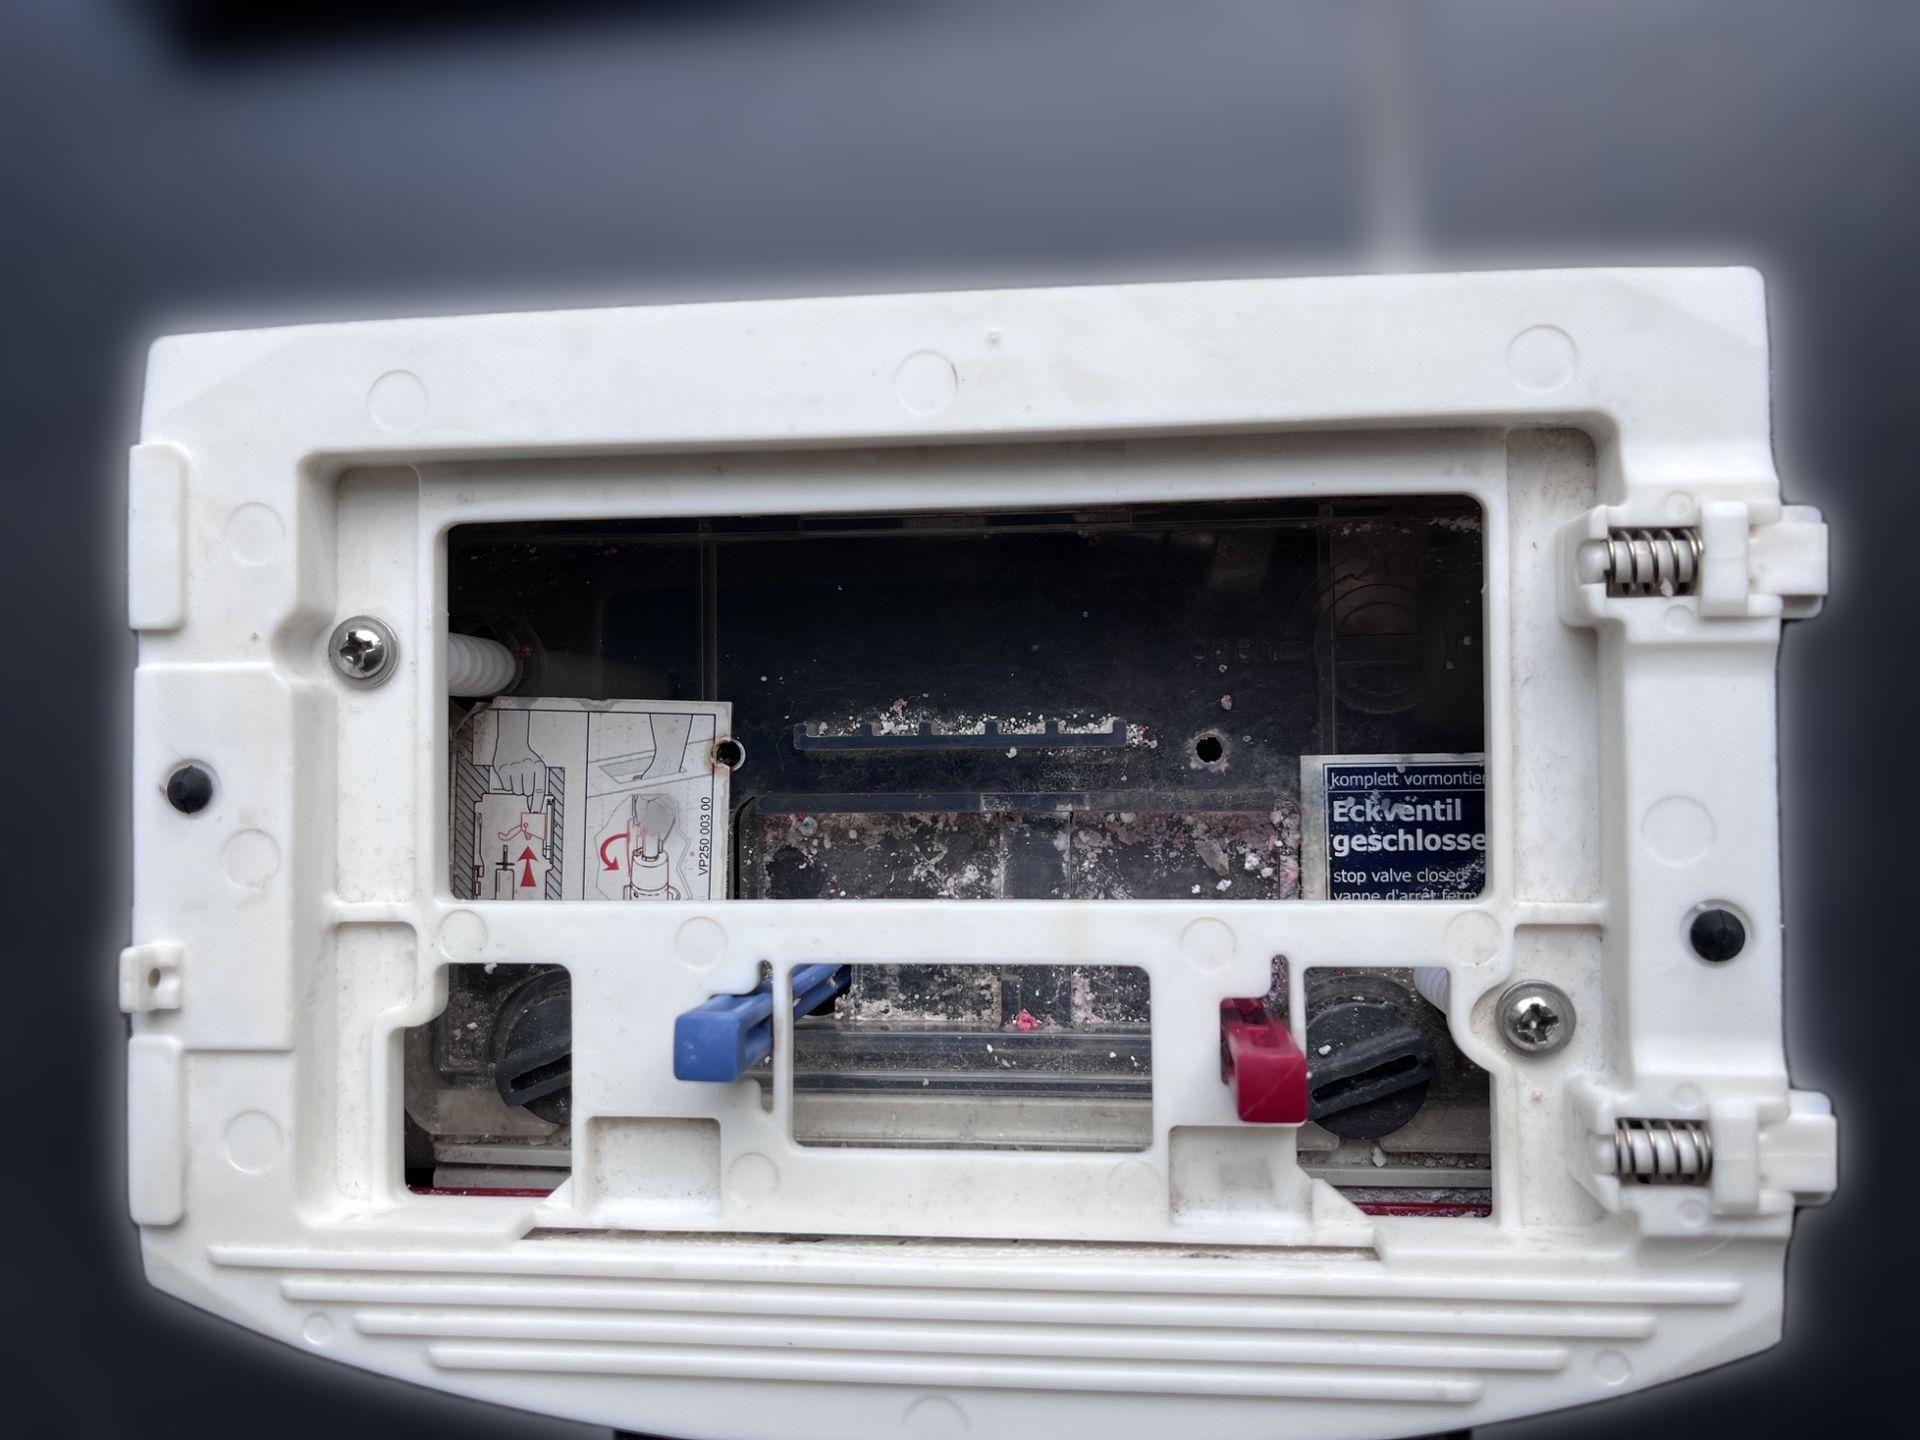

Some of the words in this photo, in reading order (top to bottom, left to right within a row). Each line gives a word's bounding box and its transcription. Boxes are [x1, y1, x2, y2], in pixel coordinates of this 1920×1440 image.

[1331, 771, 1399, 789] komplett
[700, 796, 711, 811] 00
[1332, 798, 1462, 822] Eckventil
[700, 814, 711, 835] 003
[1332, 828, 1486, 857] geschlosse
[698, 838, 710, 876] VP250
[1333, 869, 1366, 885] stop
[1371, 868, 1412, 882] valve
